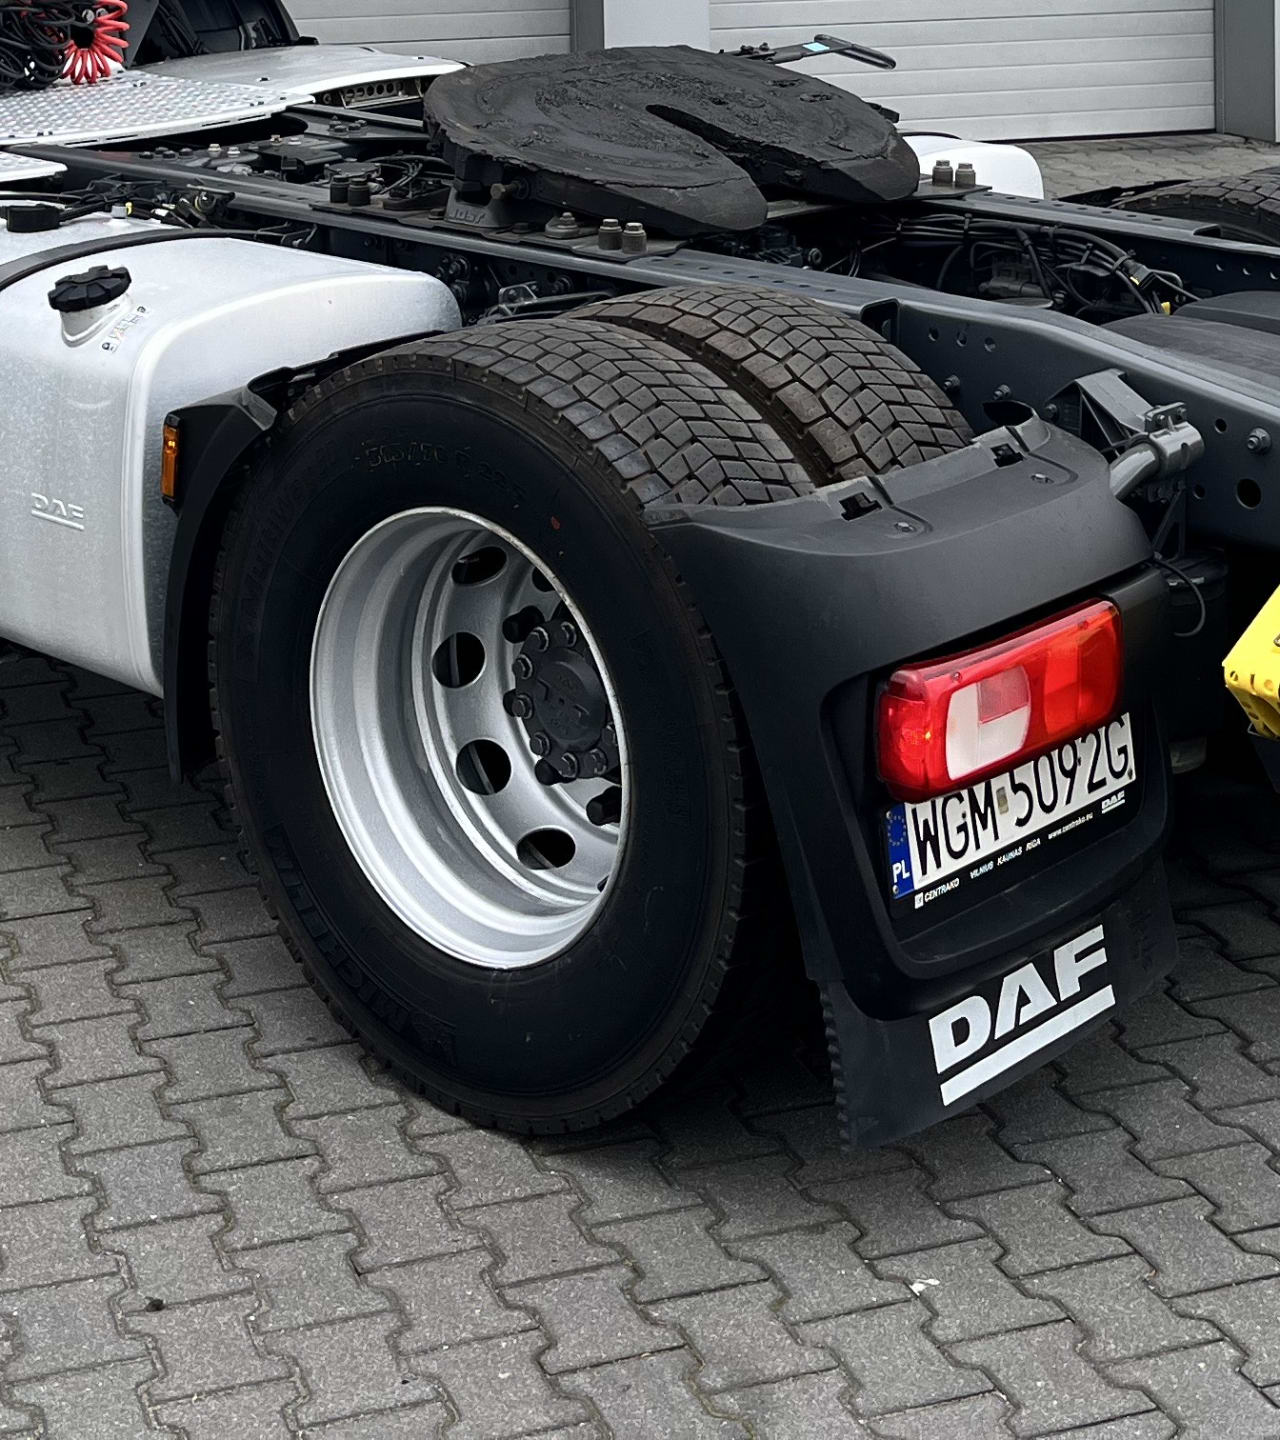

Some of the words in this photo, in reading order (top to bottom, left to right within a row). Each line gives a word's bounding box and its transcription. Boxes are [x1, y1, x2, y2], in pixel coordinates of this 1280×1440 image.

[32, 492, 84, 519] DAF
[911, 778, 1000, 878] WGM
[1008, 718, 1130, 827] 5092G
[1101, 790, 1126, 810] DAF
[892, 858, 911, 884] PL
[924, 878, 960, 903] CENTRAKO
[969, 860, 995, 879] VILNIUS
[996, 846, 1023, 866] KAUNAS
[1025, 838, 1042, 851] RIGA
[928, 924, 1109, 1075] DAF
